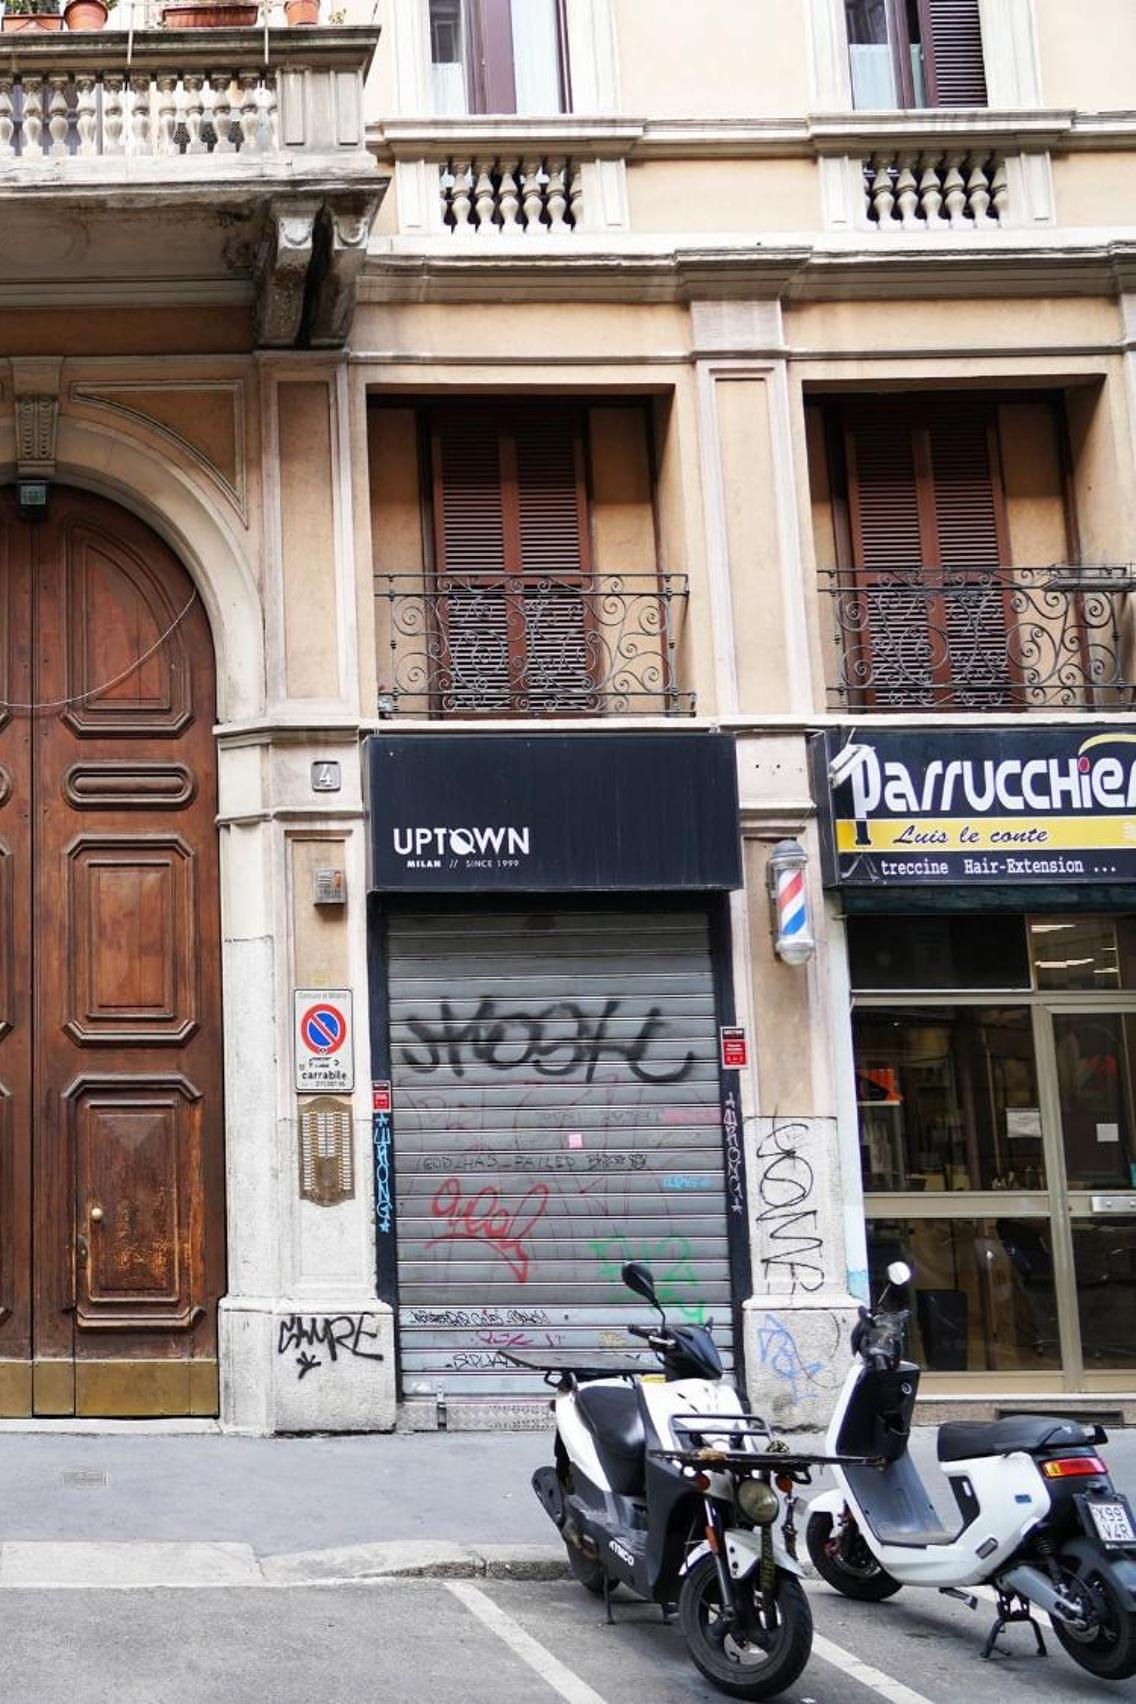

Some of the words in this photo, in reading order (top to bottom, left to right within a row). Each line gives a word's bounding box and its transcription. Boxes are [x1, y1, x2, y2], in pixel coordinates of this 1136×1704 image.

[318, 765, 333, 785] 4
[393, 827, 530, 856] UPTOWN
[893, 824, 949, 845] Luis
[959, 826, 979, 844] le
[989, 824, 1050, 844] conte
[406, 860, 442, 868] MILAN
[465, 859, 493, 868] SINCE
[497, 859, 520, 868] 1999
[880, 857, 949, 876] treccine
[964, 856, 1085, 874] Hair-Extension
[301, 1070, 348, 1081] carrabile
